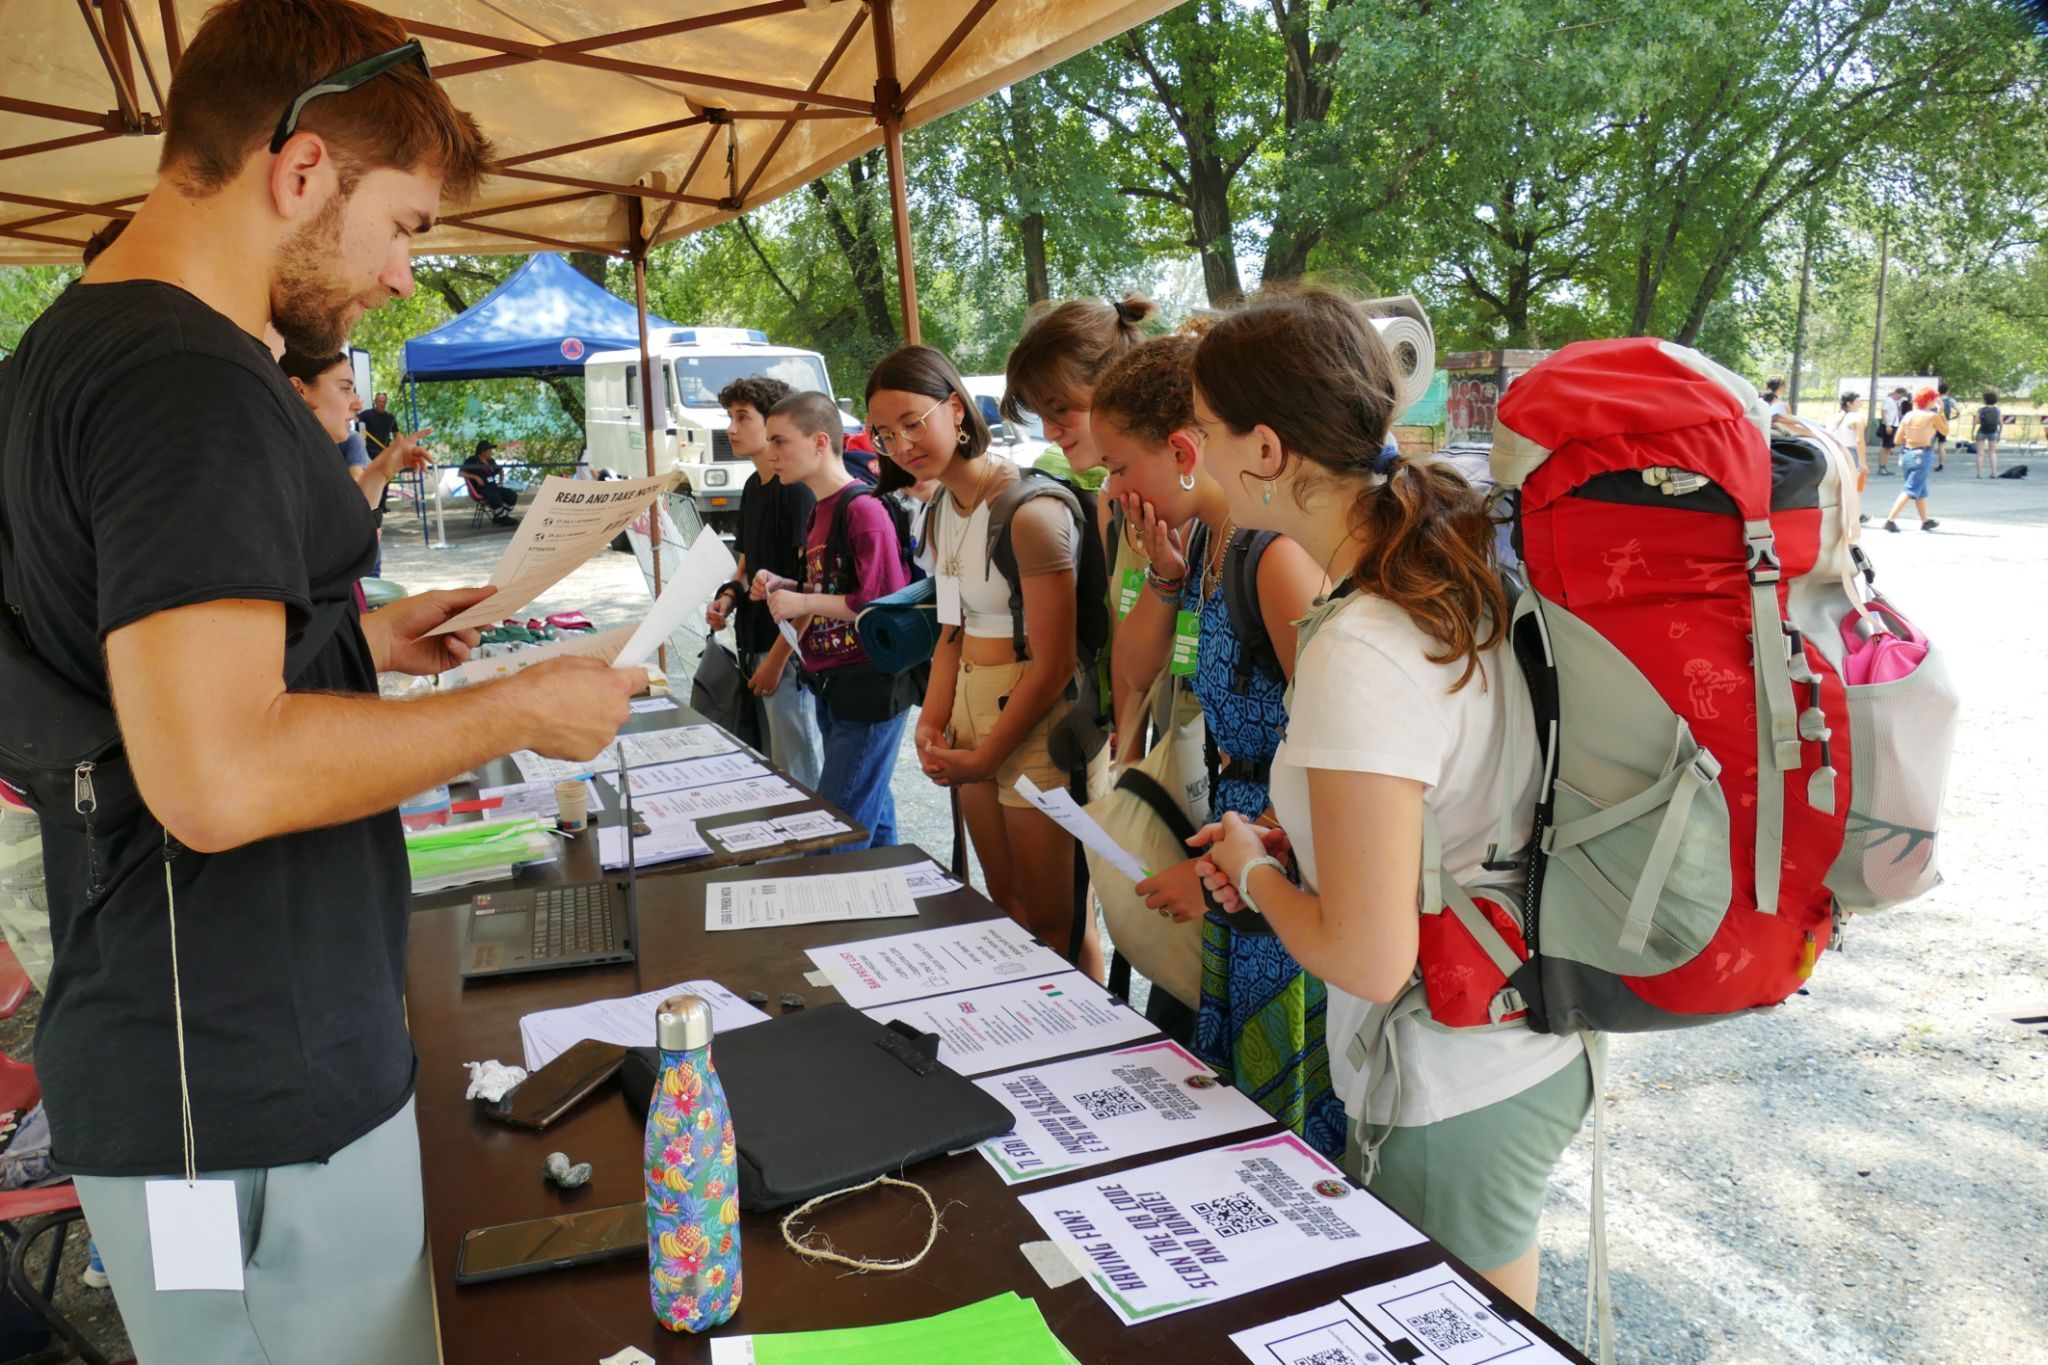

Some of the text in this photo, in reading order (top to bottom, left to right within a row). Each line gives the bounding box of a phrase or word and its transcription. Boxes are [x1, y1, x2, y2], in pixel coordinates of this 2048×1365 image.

[555, 492, 585, 504] READ
[585, 493, 610, 504] AND
[610, 489, 635, 502] TAKE
[839, 952, 881, 989] BAR PRICE LIST
[1019, 1075, 1070, 1114] DONAZIONE!
[1002, 1081, 1091, 1154] INQUADRA IL QR CODE
[1059, 1115, 1087, 1130] UNA
[1002, 1139, 1034, 1157] STAI
[1075, 1131, 1101, 1145] FAI
[1016, 1158, 1043, 1169] TI
[1255, 1157, 1303, 1190] EVERYBODY
[1235, 1169, 1320, 1237] YOU ARE MAKING THIS
[1241, 1159, 1344, 1240] EXPERIENCE POSSIBLE AND
[1296, 1191, 1320, 1204] FOR
[1097, 1184, 1217, 1289] SCAN THE QR CODE
[1137, 1192, 1227, 1264] AND DONATE!
[1054, 1210, 1146, 1290] HAVING FUN?
